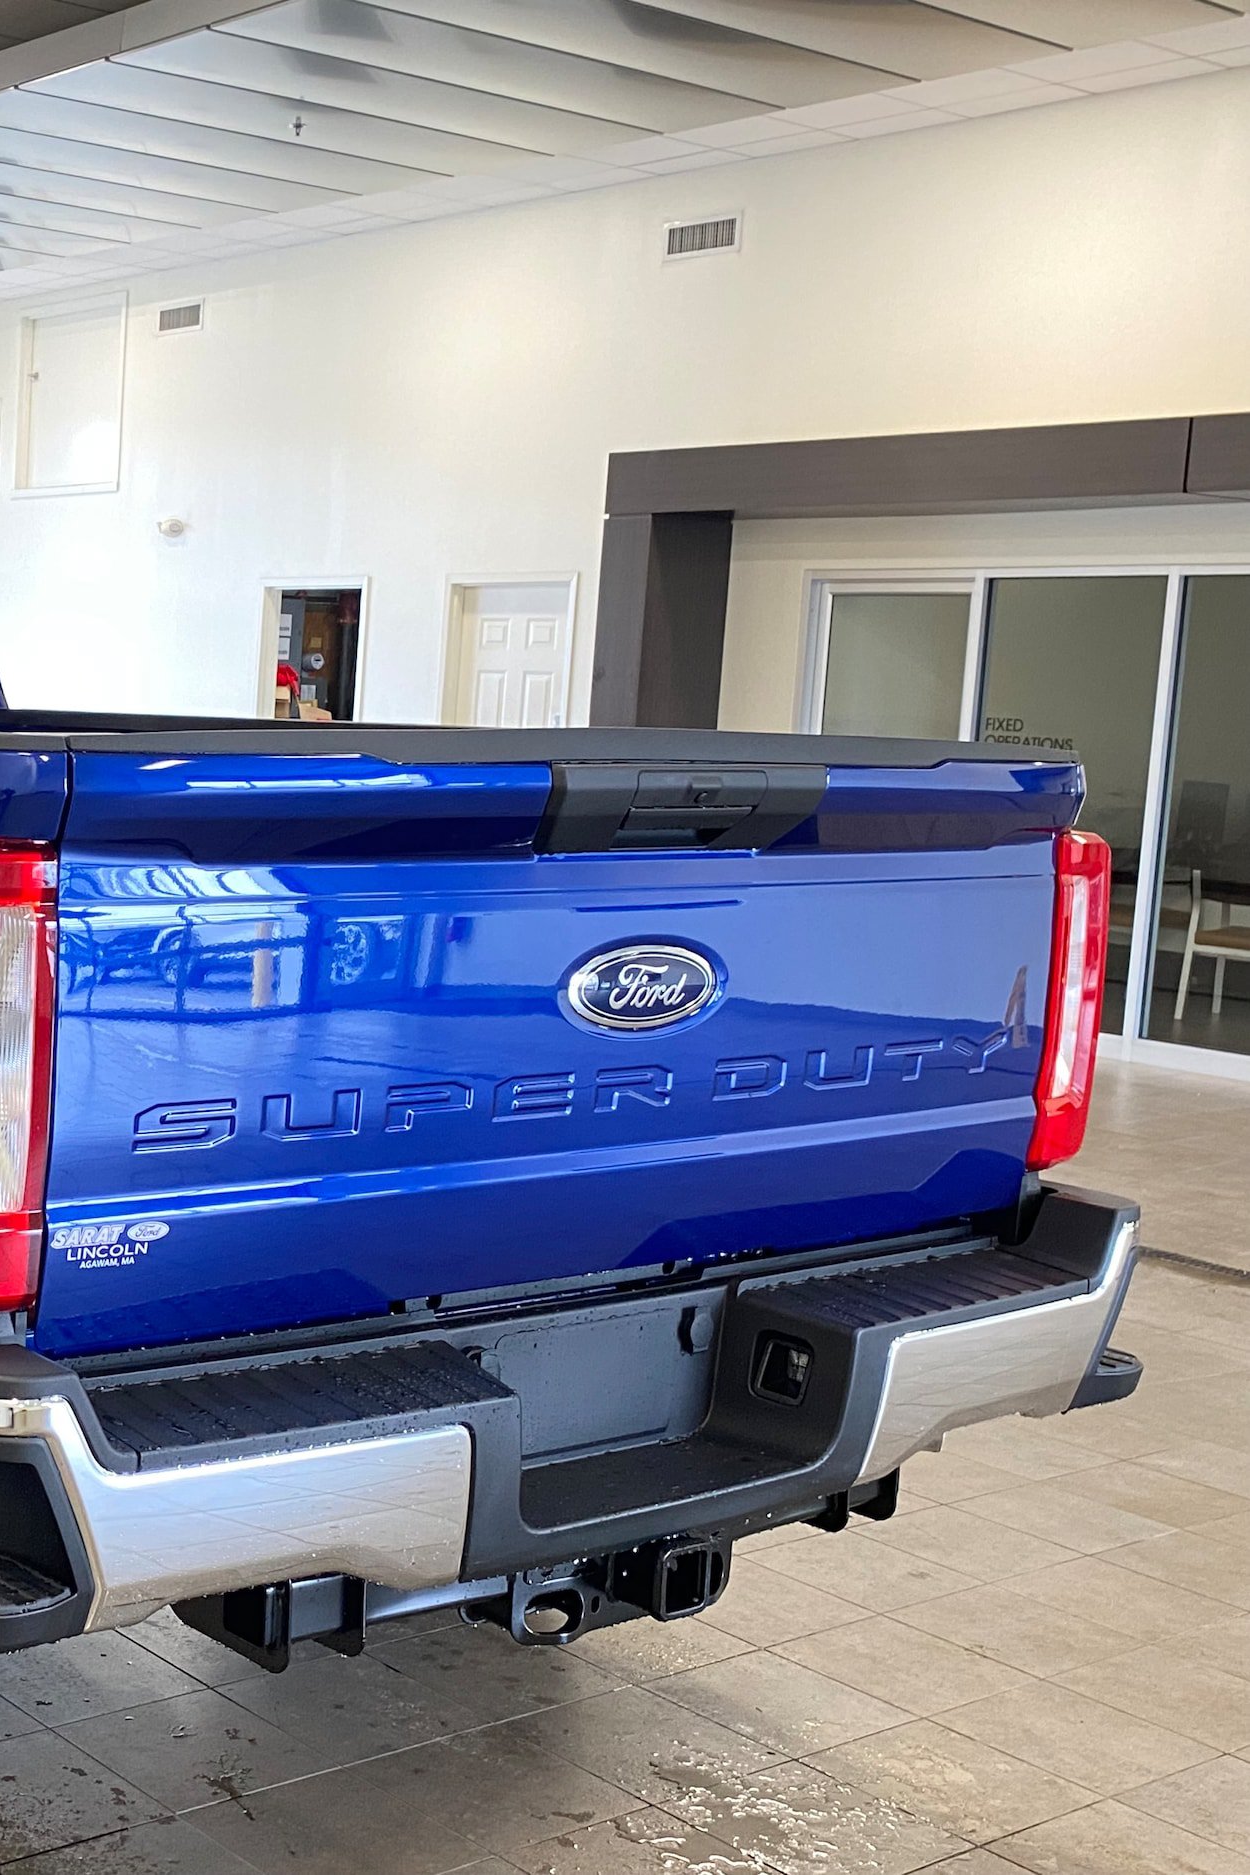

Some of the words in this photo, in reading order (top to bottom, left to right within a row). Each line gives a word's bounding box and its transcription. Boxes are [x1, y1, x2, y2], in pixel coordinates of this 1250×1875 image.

[985, 717, 1024, 732] FIXED
[609, 963, 688, 1010] Ford
[131, 1063, 674, 1154] SUPER
[712, 1028, 1010, 1102] DUTY
[51, 1223, 126, 1249] SARAT
[134, 1225, 159, 1237] Ford
[67, 1242, 149, 1261] LINCOLN
[121, 1256, 135, 1265] MA
